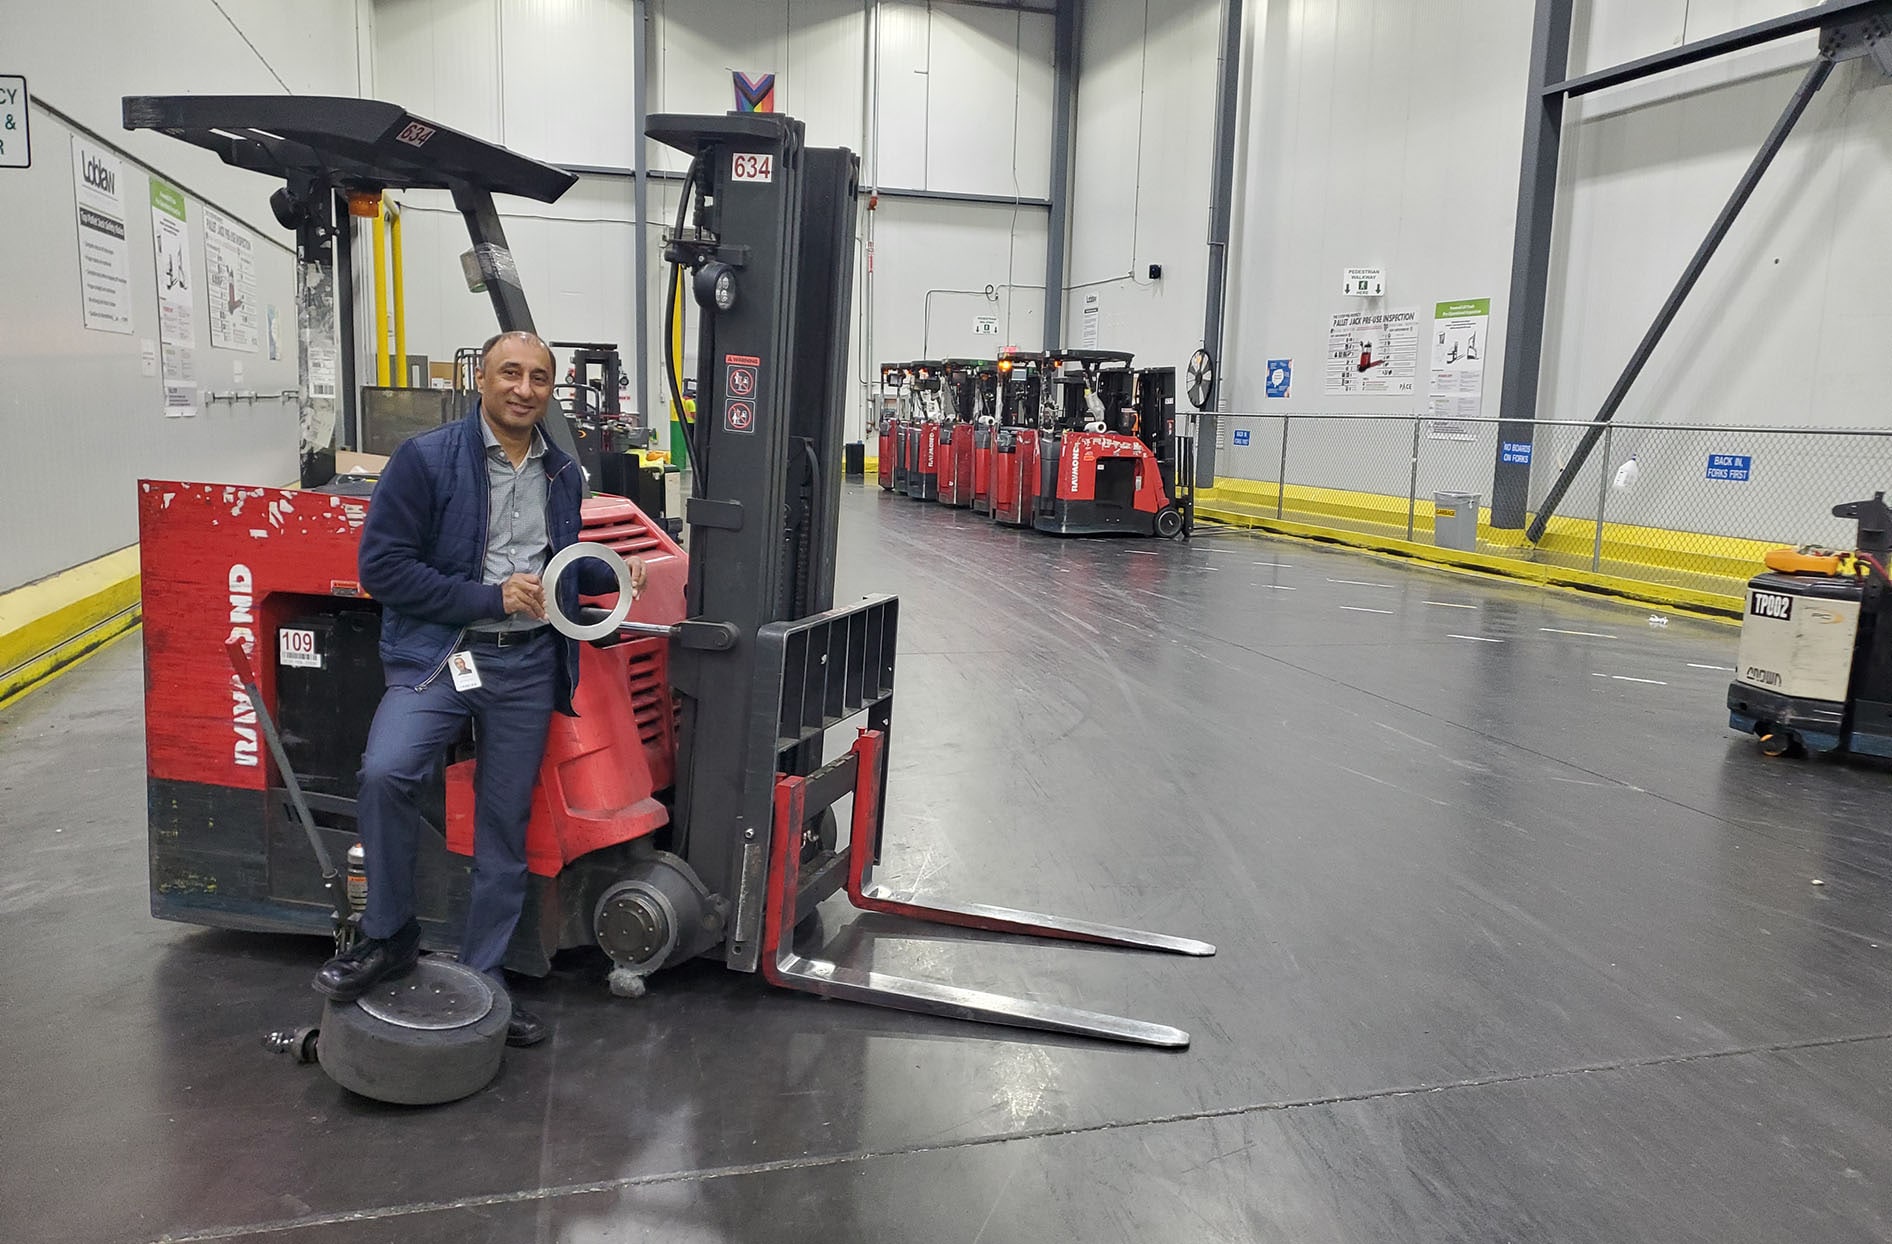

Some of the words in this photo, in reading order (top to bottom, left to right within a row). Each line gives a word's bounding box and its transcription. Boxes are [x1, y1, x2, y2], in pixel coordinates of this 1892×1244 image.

[401, 124, 433, 145] 634
[734, 155, 771, 179] 634
[1333, 319, 1349, 327] PALLET
[1349, 317, 1361, 326] JACK
[1361, 315, 1382, 325] PRE-USE
[1382, 312, 1415, 323] INSPECTION
[733, 356, 759, 364] WARNING
[1511, 454, 1529, 463] FORKS
[1713, 456, 1733, 466] BACK
[1707, 468, 1728, 478] FORKS
[1728, 469, 1748, 479] FIRST
[1754, 592, 1790, 618] TP002
[282, 631, 312, 653] 109
